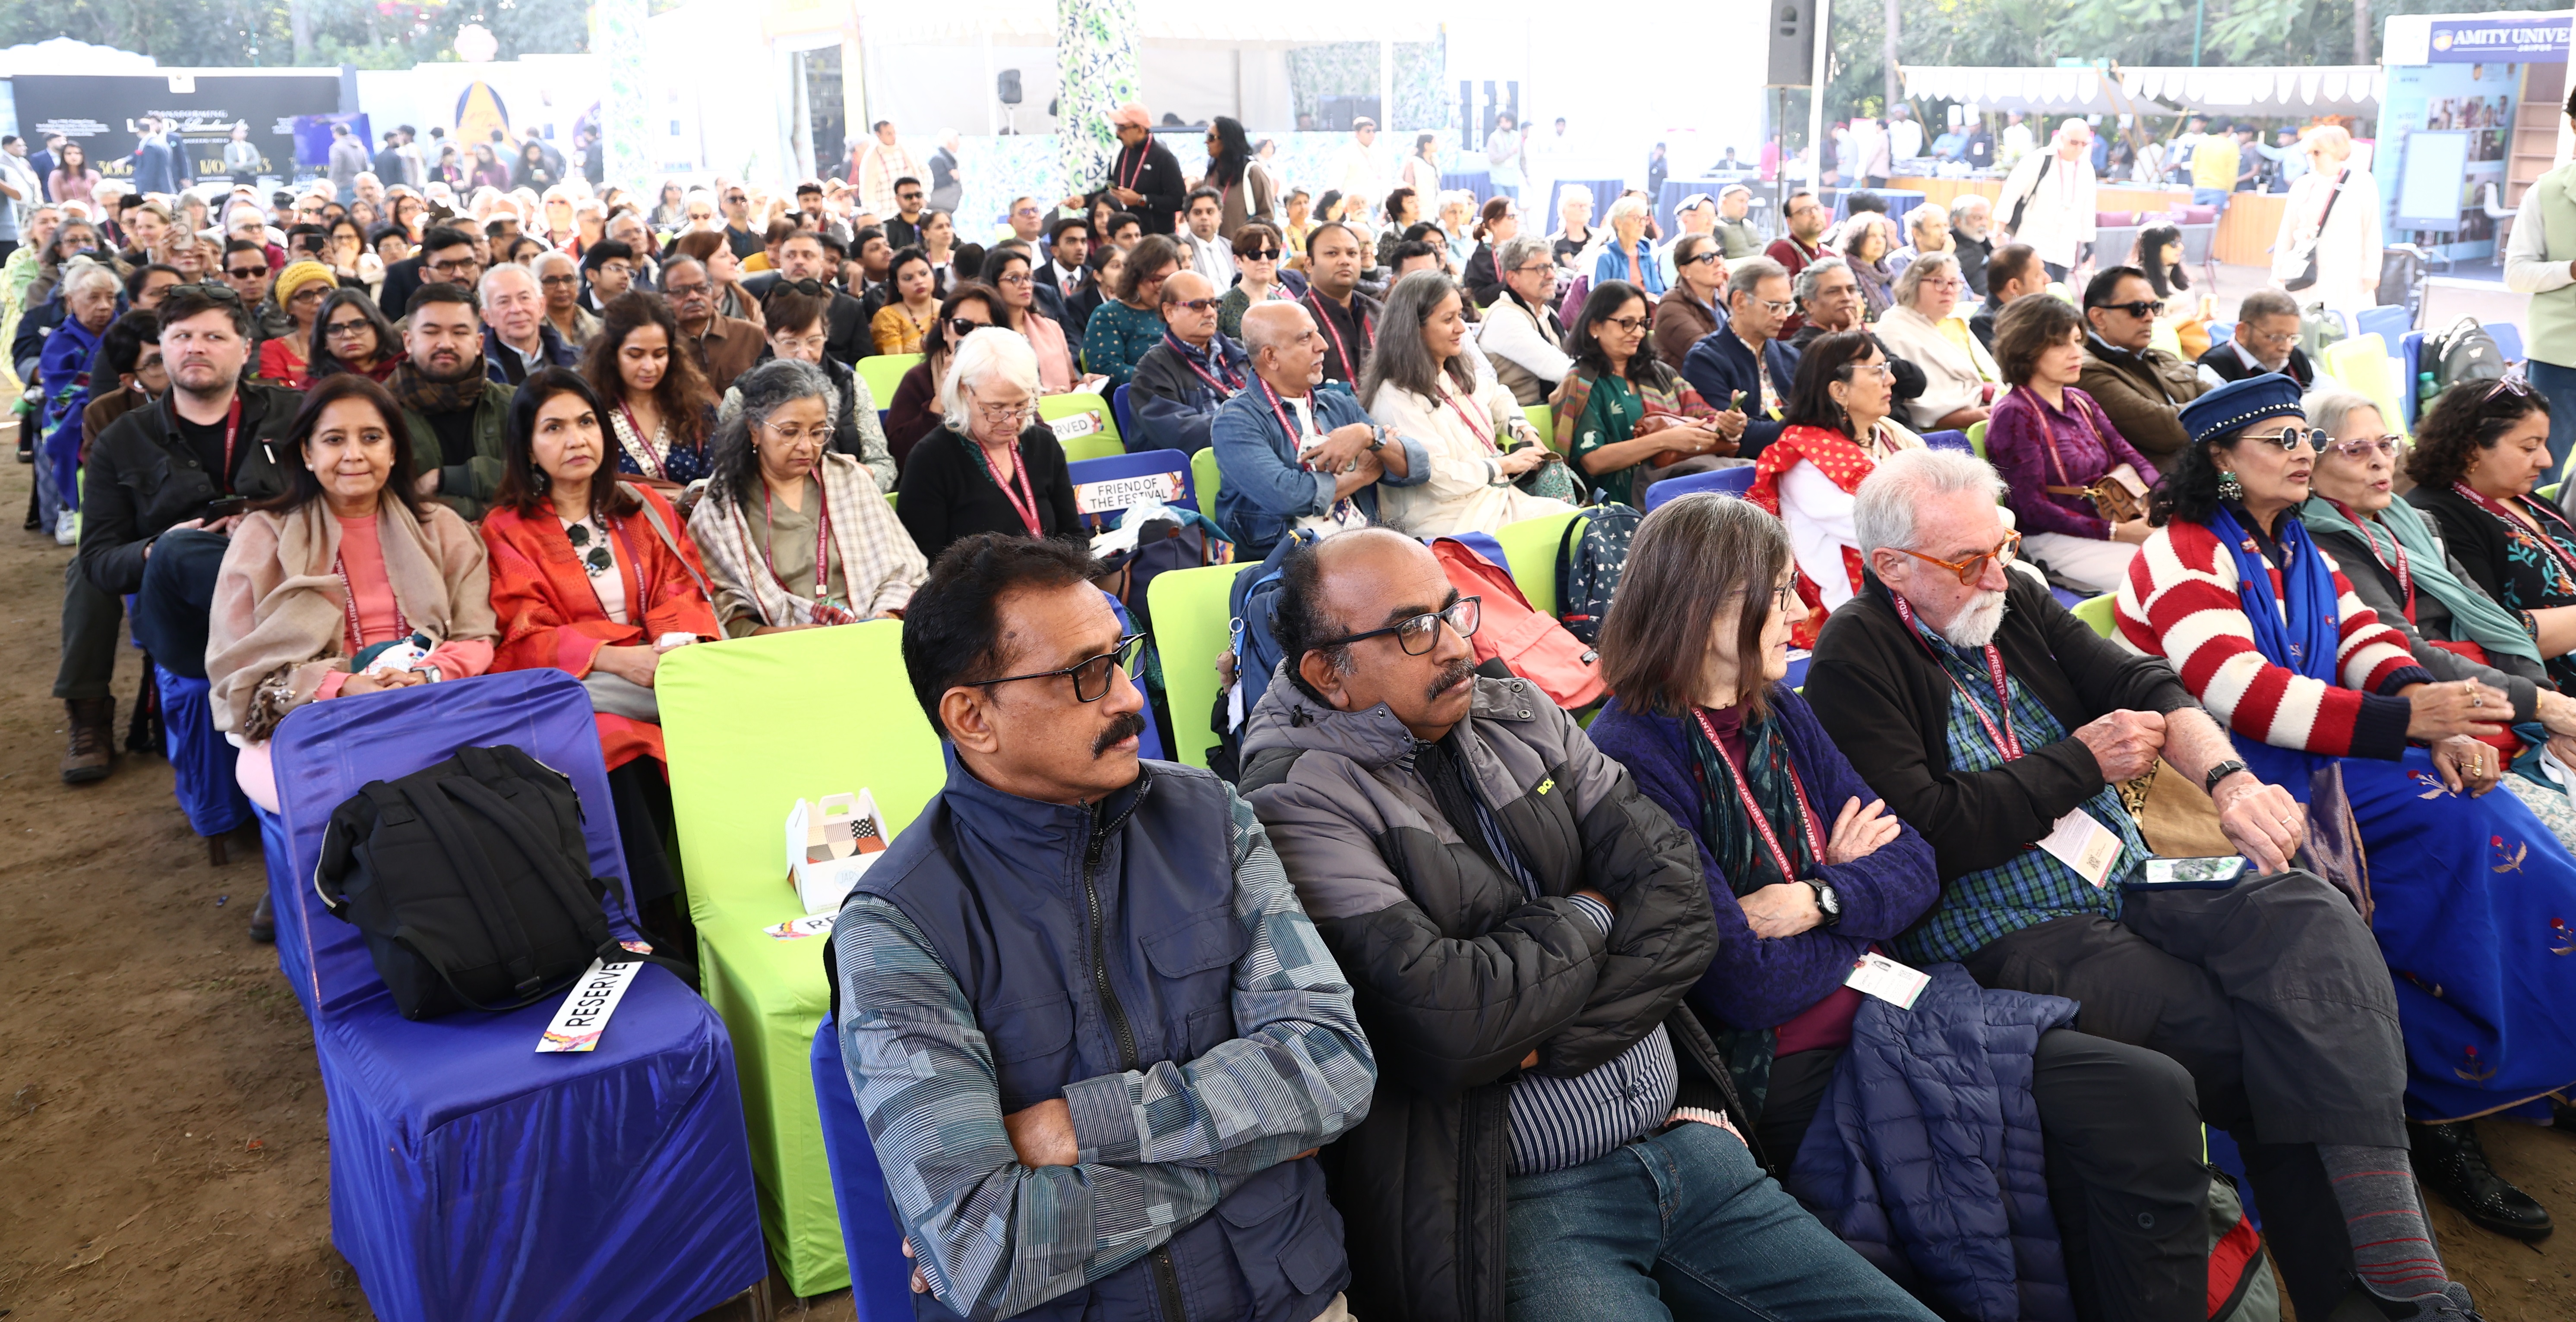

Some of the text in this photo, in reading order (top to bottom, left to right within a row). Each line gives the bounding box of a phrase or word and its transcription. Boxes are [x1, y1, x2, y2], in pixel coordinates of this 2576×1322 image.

[2453, 27, 2570, 44] AMITY UNIVE
[1055, 420, 1087, 435] RVED
[988, 463, 1007, 488] PRESENTS
[1018, 467, 1031, 499] LITERATURE
[1097, 478, 1157, 496] FRIEND OF
[1090, 496, 1115, 509] THE
[634, 562, 644, 590] VEDANTA
[2399, 559, 2408, 590] PRESENTS
[352, 622, 362, 644] JAIPUR
[1990, 653, 2005, 694] PRESENTS
[1997, 735, 2012, 761] AIPUR
[1691, 707, 1790, 874] EDANTA PRESENTS JAIPUR LITERATURE
[839, 870, 859, 884] JARS
[565, 964, 628, 1027] RESERVE
